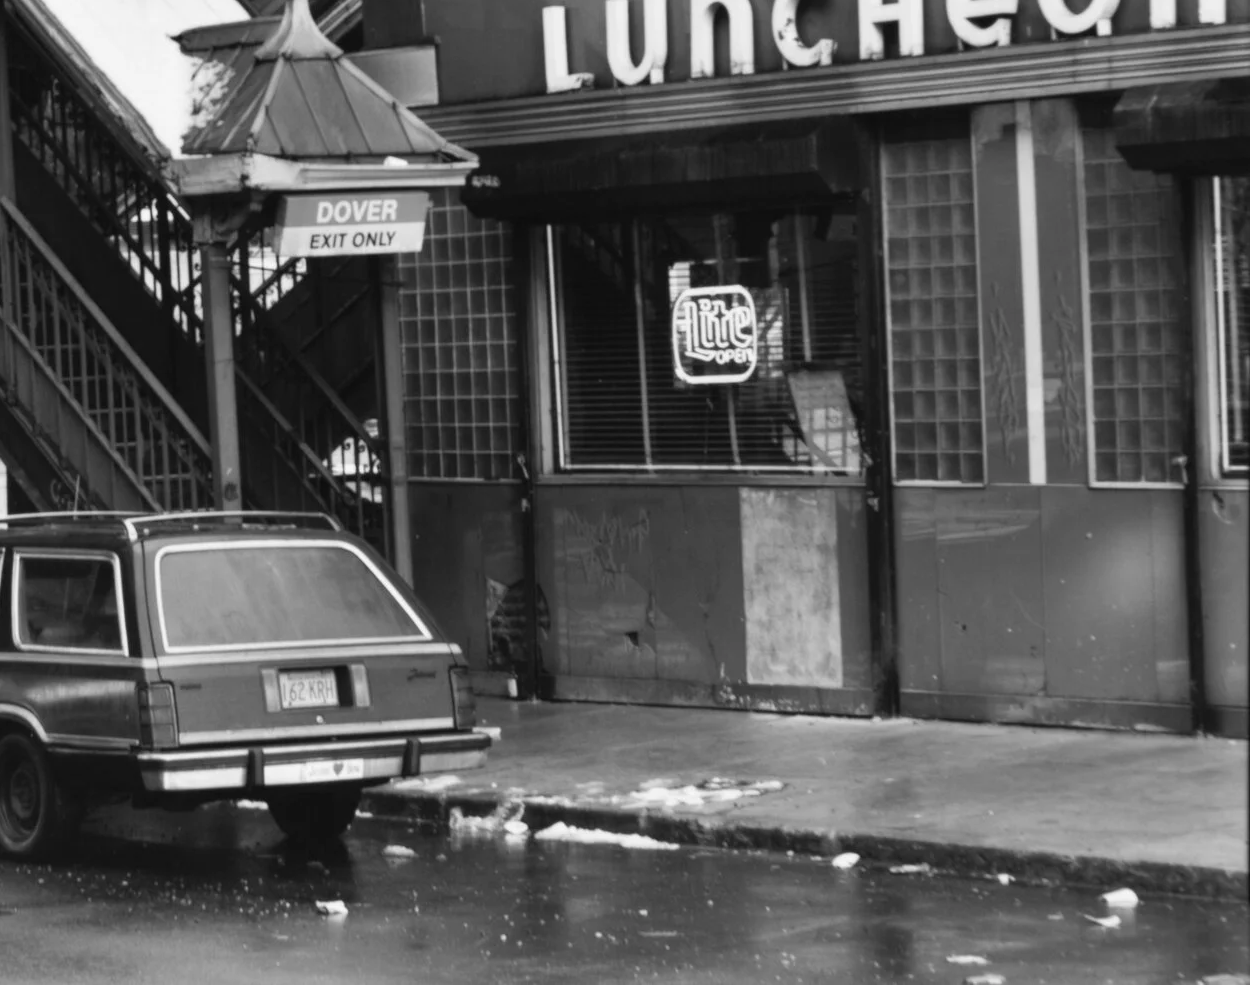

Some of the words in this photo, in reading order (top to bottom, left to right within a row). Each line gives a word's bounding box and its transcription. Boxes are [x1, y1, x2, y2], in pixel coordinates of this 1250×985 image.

[317, 199, 398, 224] DOVER
[310, 233, 347, 250] EXIT
[352, 231, 396, 248] ONLY
[308, 679, 334, 700] KRH
